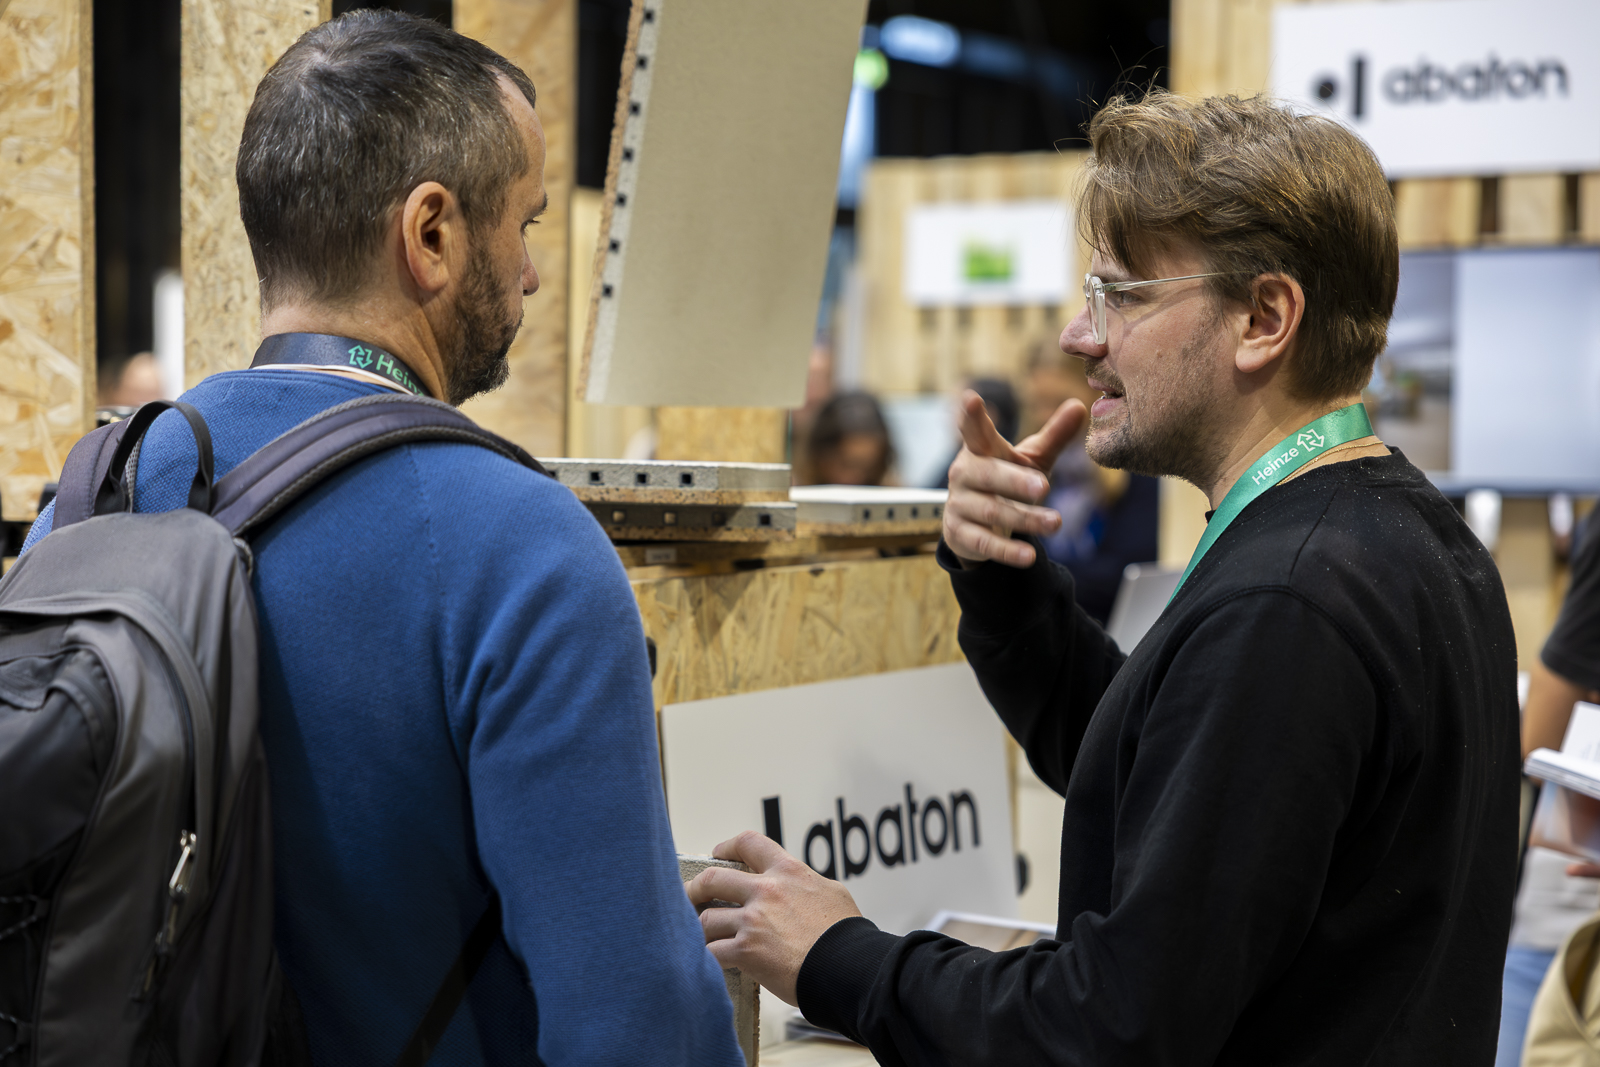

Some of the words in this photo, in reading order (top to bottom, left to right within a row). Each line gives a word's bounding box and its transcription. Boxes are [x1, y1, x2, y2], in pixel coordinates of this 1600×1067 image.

[1384, 53, 1568, 104] abaton
[1252, 447, 1299, 485] Heinze
[804, 783, 981, 880] abaton
